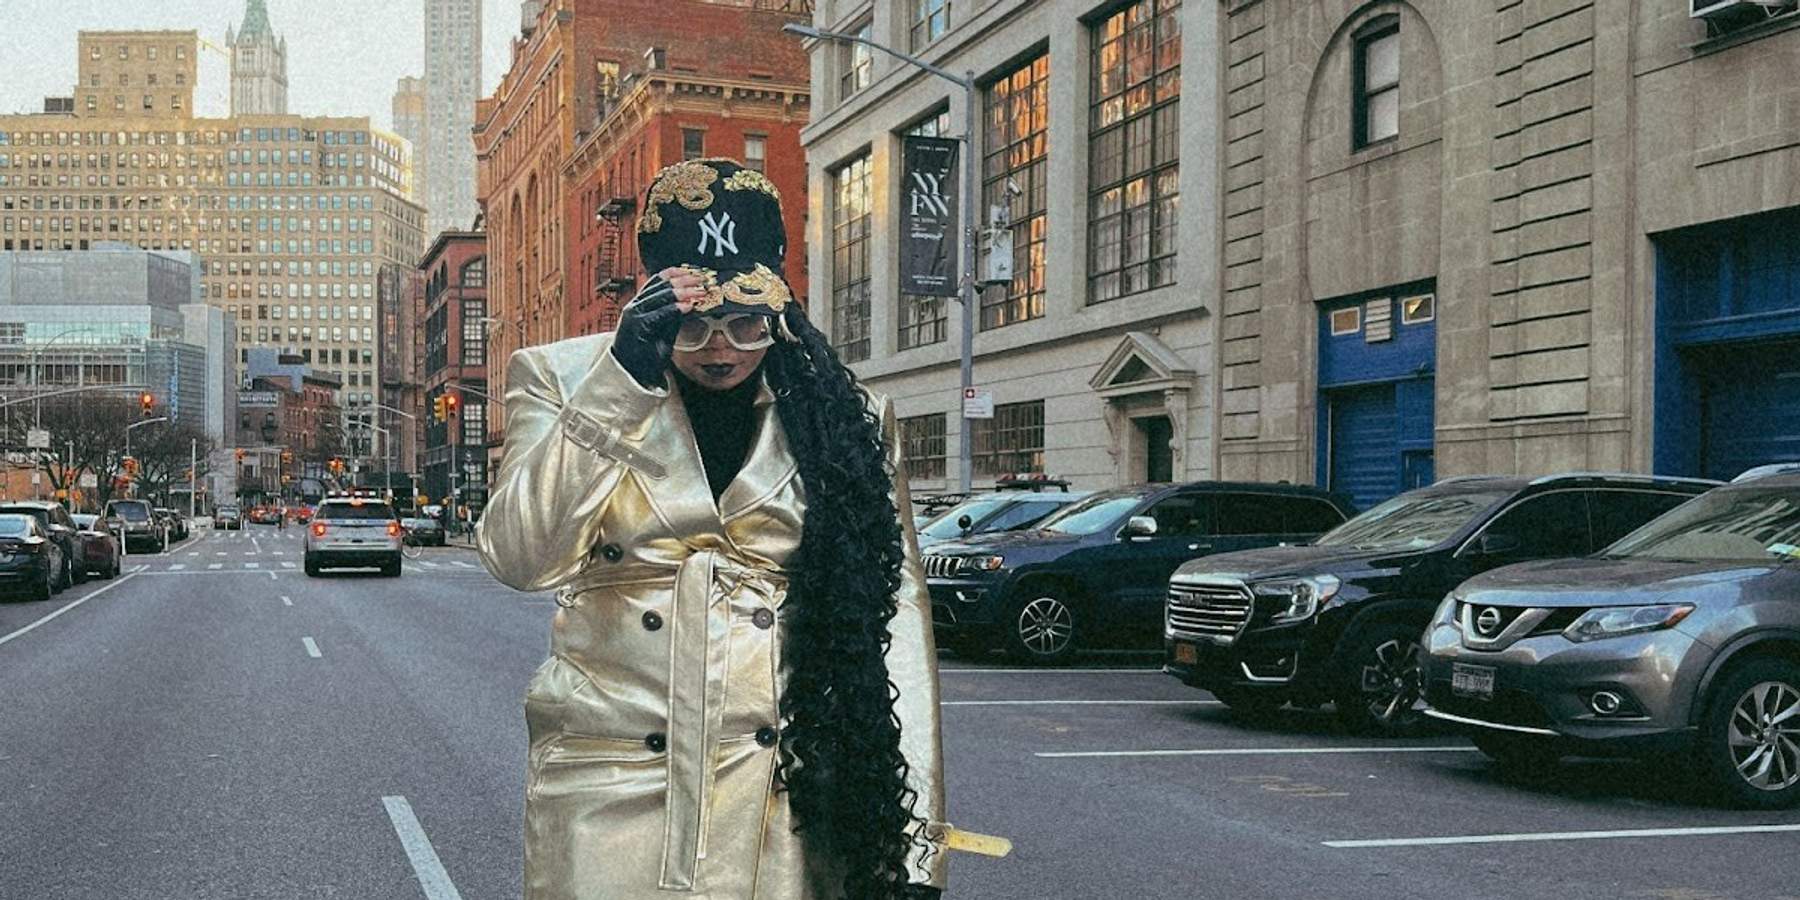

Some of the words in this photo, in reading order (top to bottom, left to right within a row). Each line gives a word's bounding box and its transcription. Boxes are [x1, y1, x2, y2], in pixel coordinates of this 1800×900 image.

[911, 168, 948, 194] NY
[910, 192, 951, 216] FW
[698, 212, 739, 257] NY
